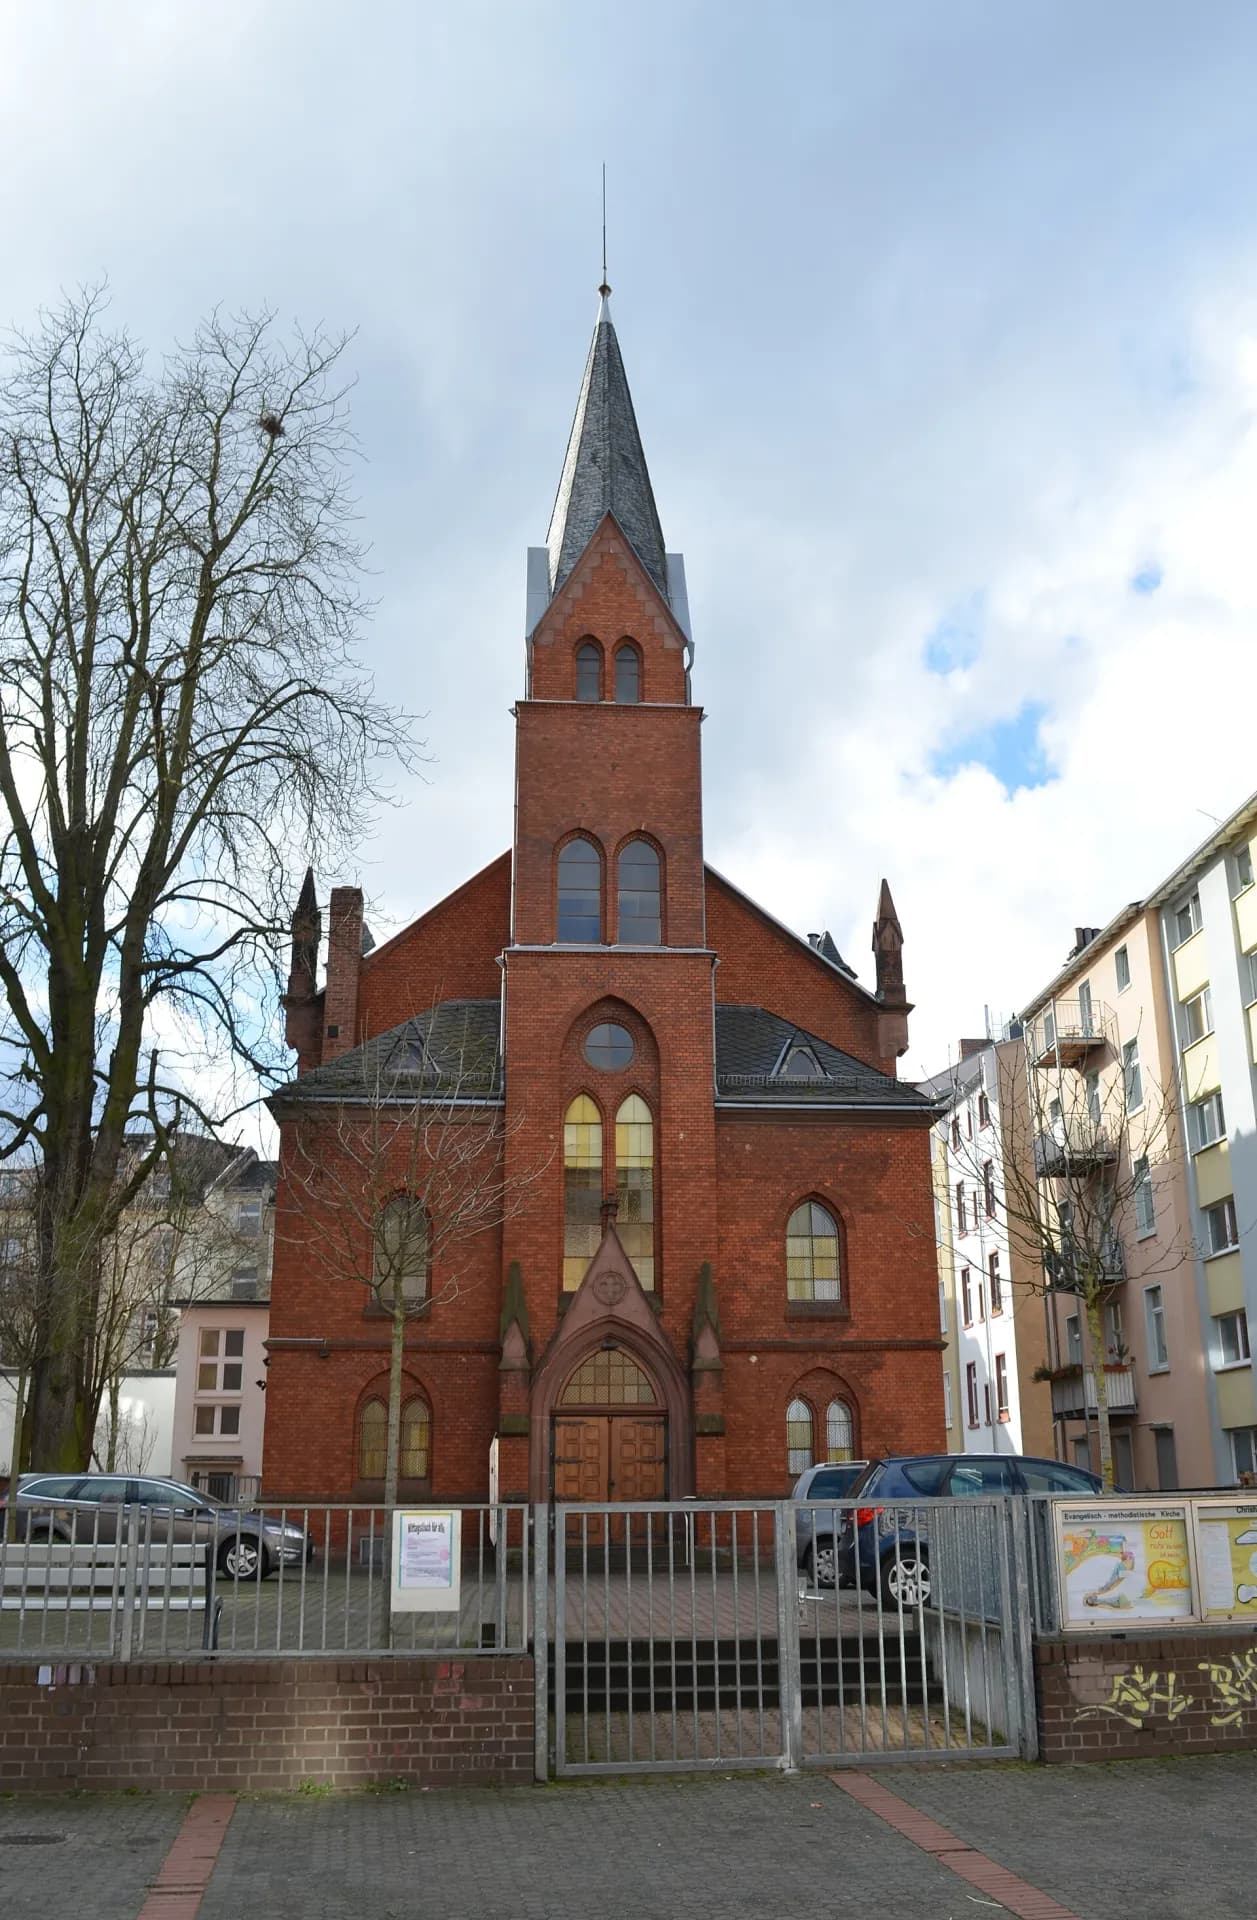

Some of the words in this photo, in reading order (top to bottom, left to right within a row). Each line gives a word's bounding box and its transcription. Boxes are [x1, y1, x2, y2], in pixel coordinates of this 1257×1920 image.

[1064, 1512, 1102, 1521] Evangelisch
[1108, 1511, 1155, 1519] methodistische
[1160, 1510, 1181, 1518] Kirche
[1149, 1524, 1174, 1540] Gott
